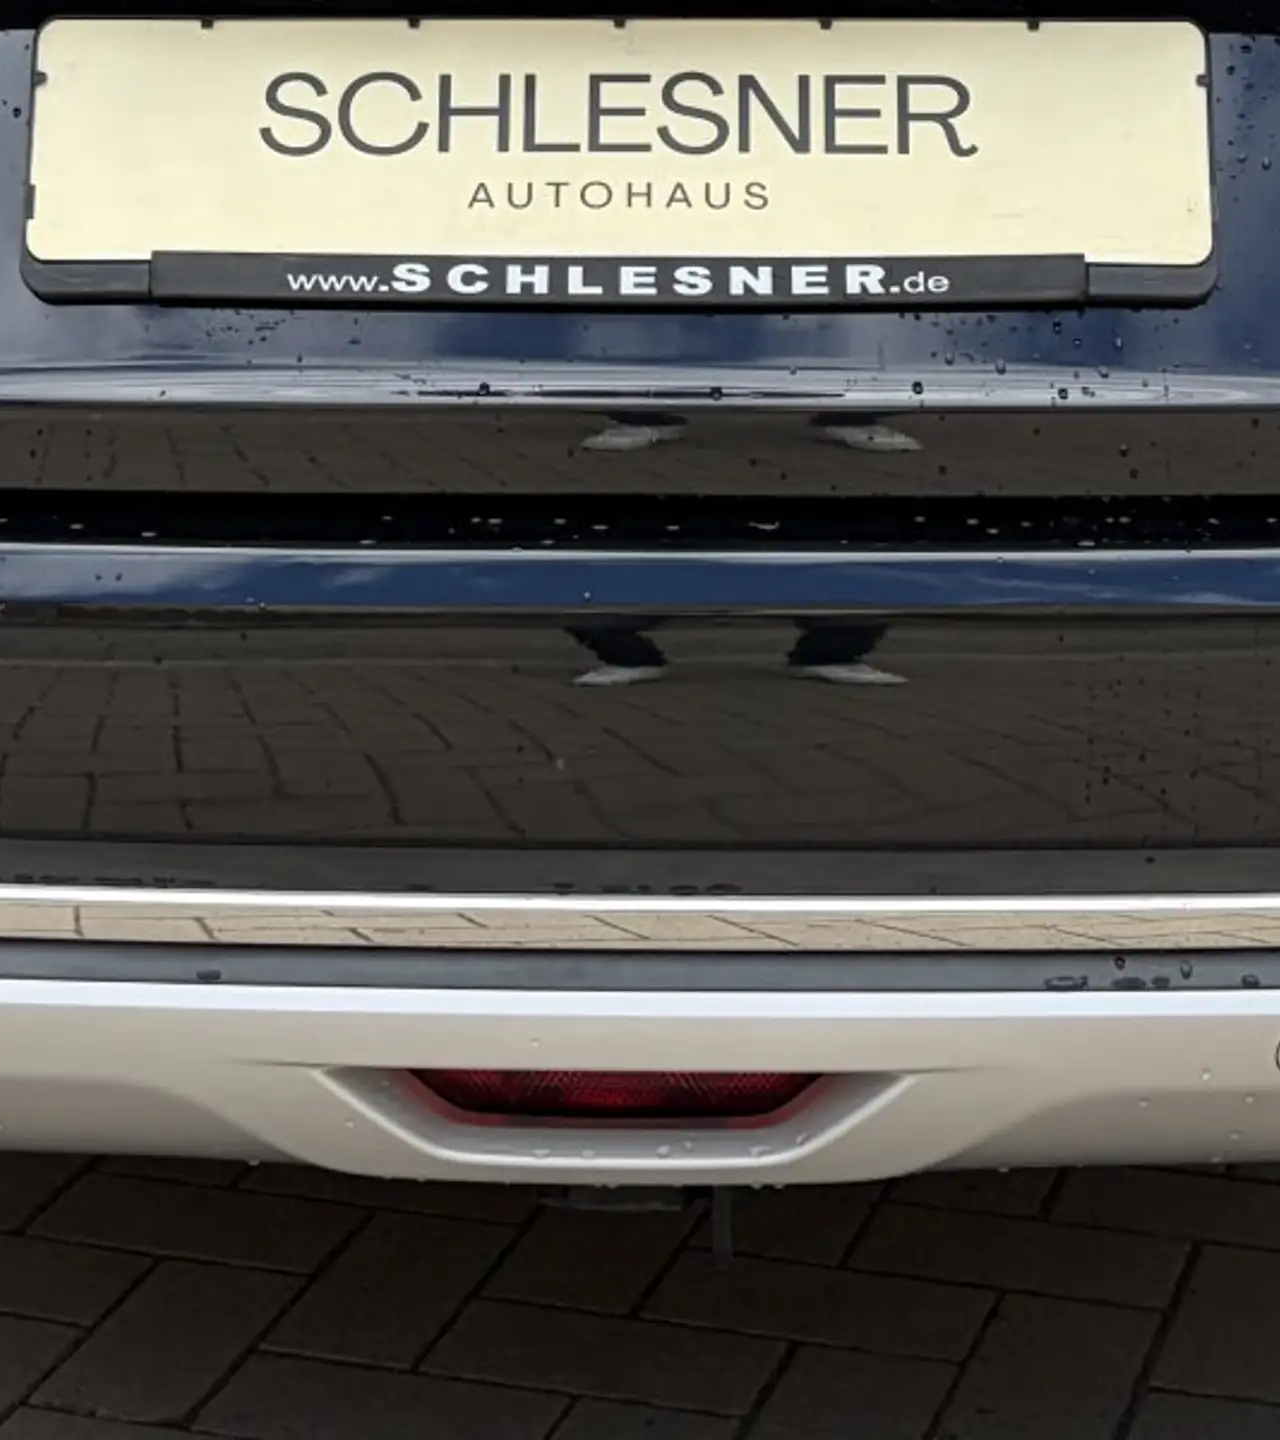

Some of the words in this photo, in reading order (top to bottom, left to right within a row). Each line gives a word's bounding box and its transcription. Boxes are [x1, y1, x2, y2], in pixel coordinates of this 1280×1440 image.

[258, 71, 979, 158] SCHLESNER
[467, 180, 770, 211] AUTOHAUS
[286, 262, 950, 297] www.SCHLESNER.de
